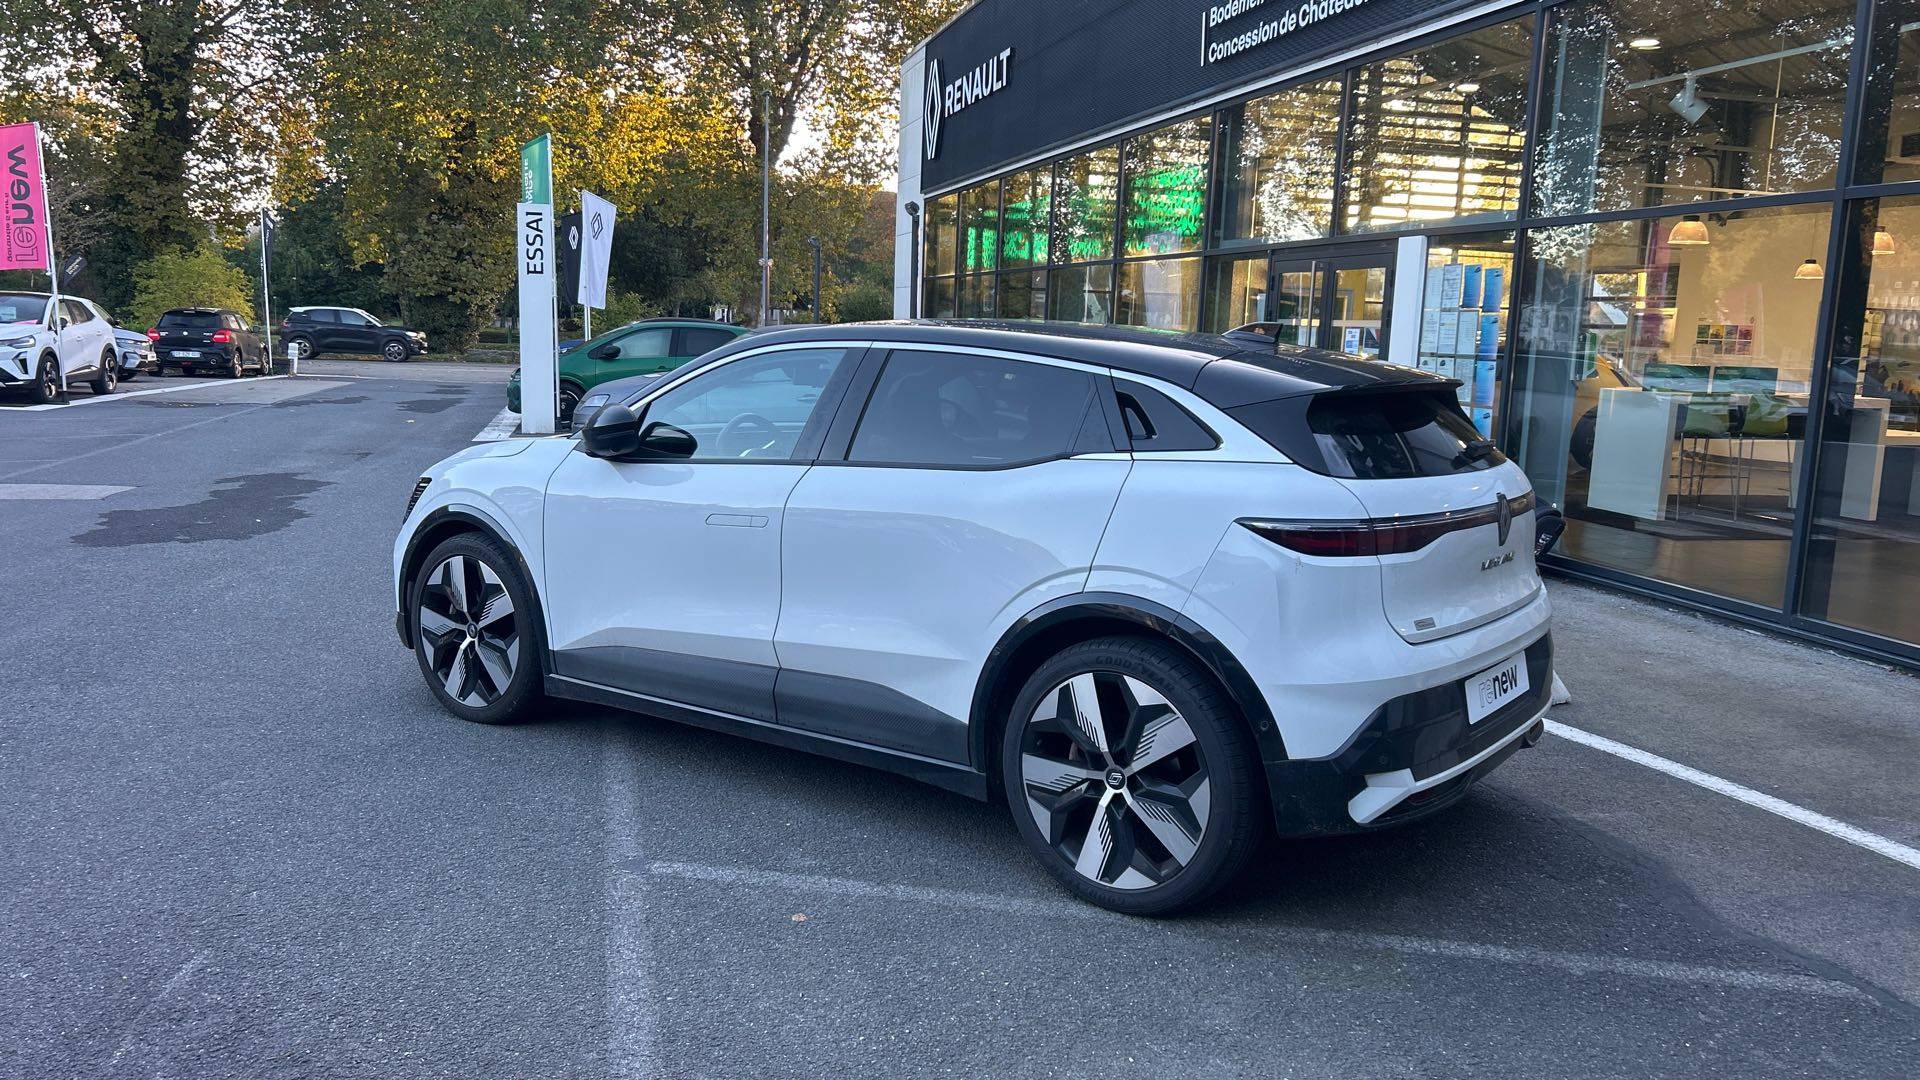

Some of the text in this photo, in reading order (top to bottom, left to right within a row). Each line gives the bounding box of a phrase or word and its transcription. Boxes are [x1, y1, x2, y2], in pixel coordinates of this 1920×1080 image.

[1208, 21, 1278, 63] Concession
[1279, 10, 1297, 35] de
[945, 47, 1011, 118] RENAULT
[526, 211, 544, 275] ESSAI
[1478, 664, 1518, 709] renew
